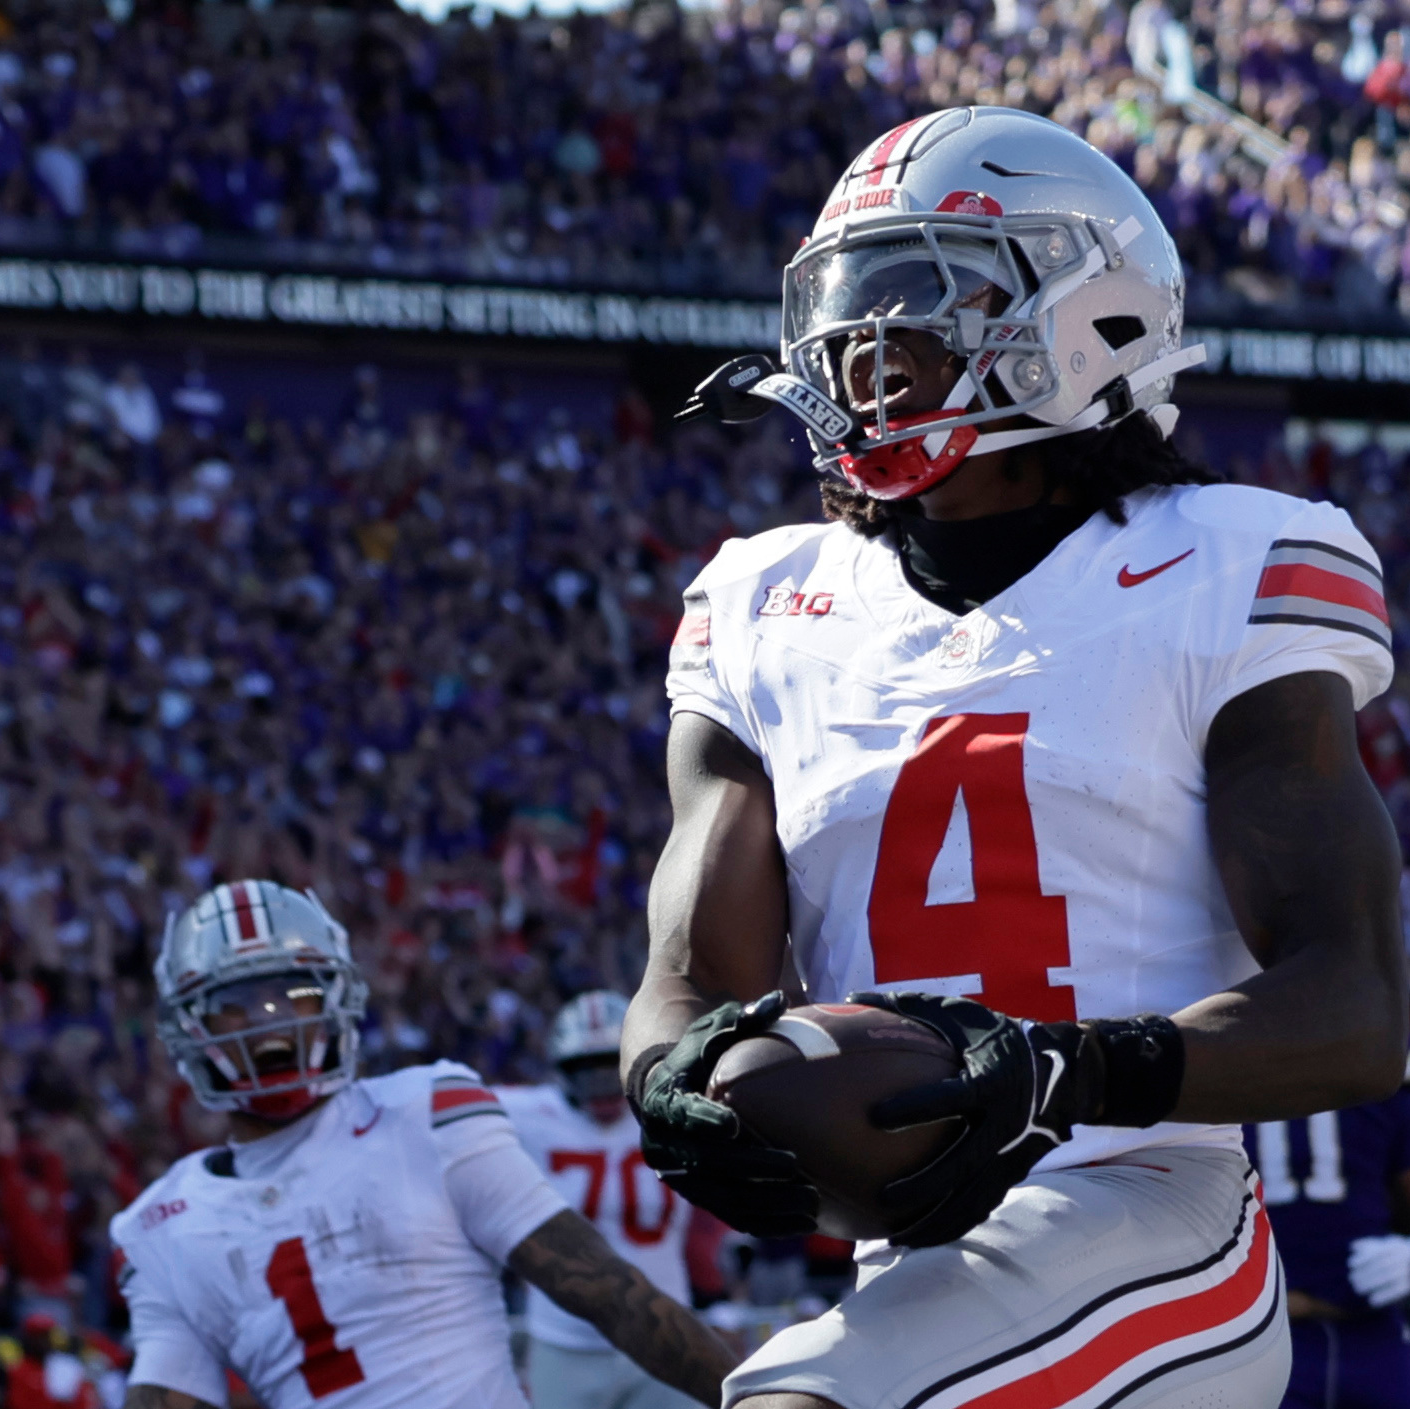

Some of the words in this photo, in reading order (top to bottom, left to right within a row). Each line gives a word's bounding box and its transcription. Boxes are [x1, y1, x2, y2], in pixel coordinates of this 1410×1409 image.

[760, 379, 847, 437] BATTLE
[866, 711, 1077, 1022] 4
[548, 1147, 676, 1248] 70
[1255, 1109, 1348, 1206] 11
[265, 1236, 366, 1399] 1
